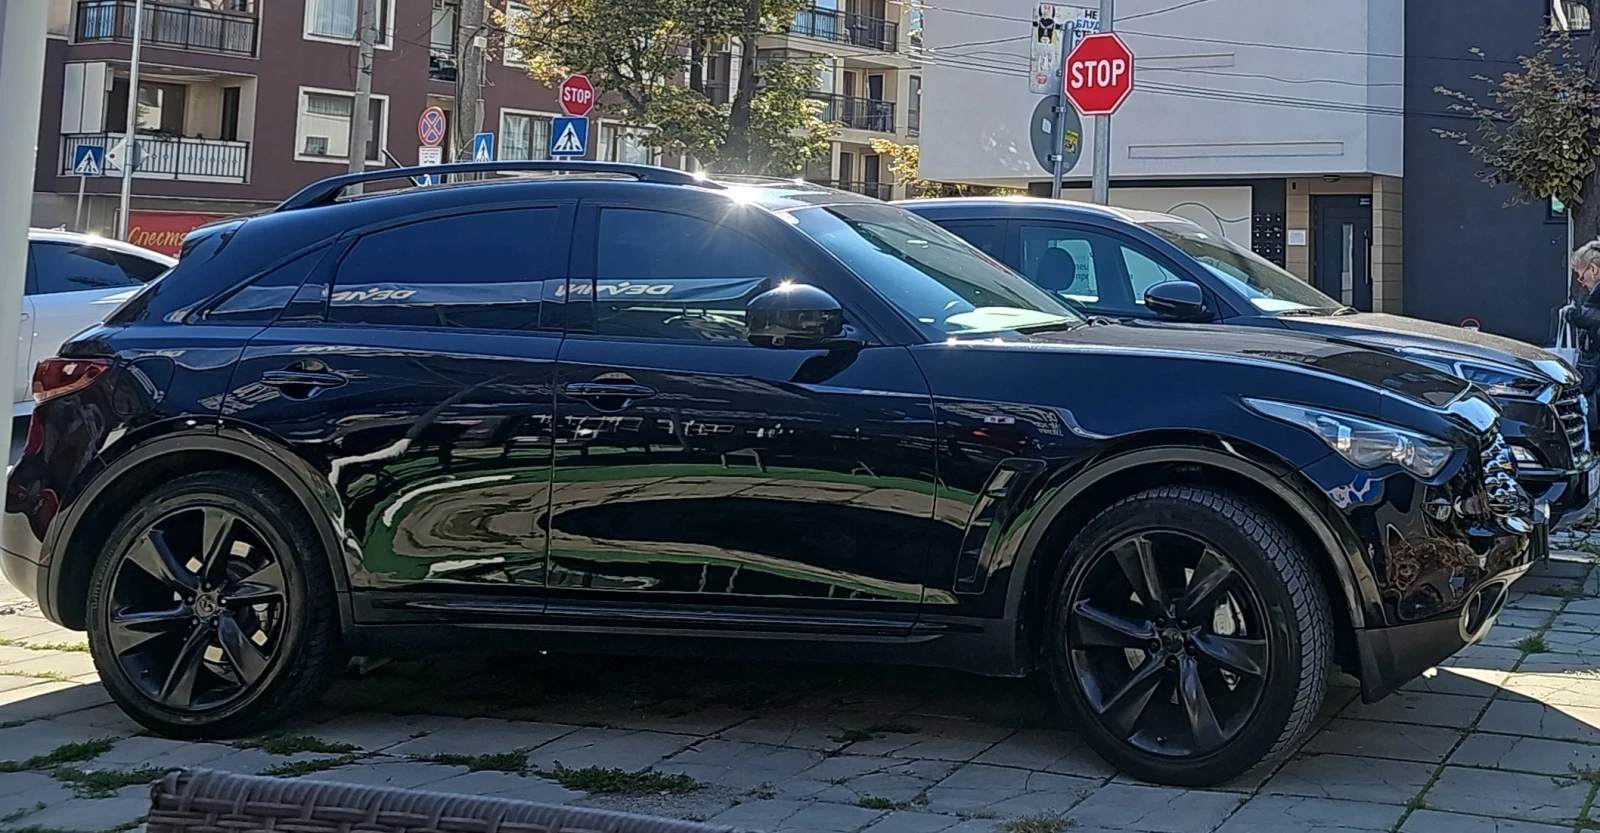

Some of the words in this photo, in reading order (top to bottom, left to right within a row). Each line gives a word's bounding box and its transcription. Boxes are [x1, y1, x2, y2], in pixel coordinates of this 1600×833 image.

[1085, 10, 1098, 19] НЕ
[1071, 59, 1125, 89] STOP
[563, 86, 592, 104] STOP
